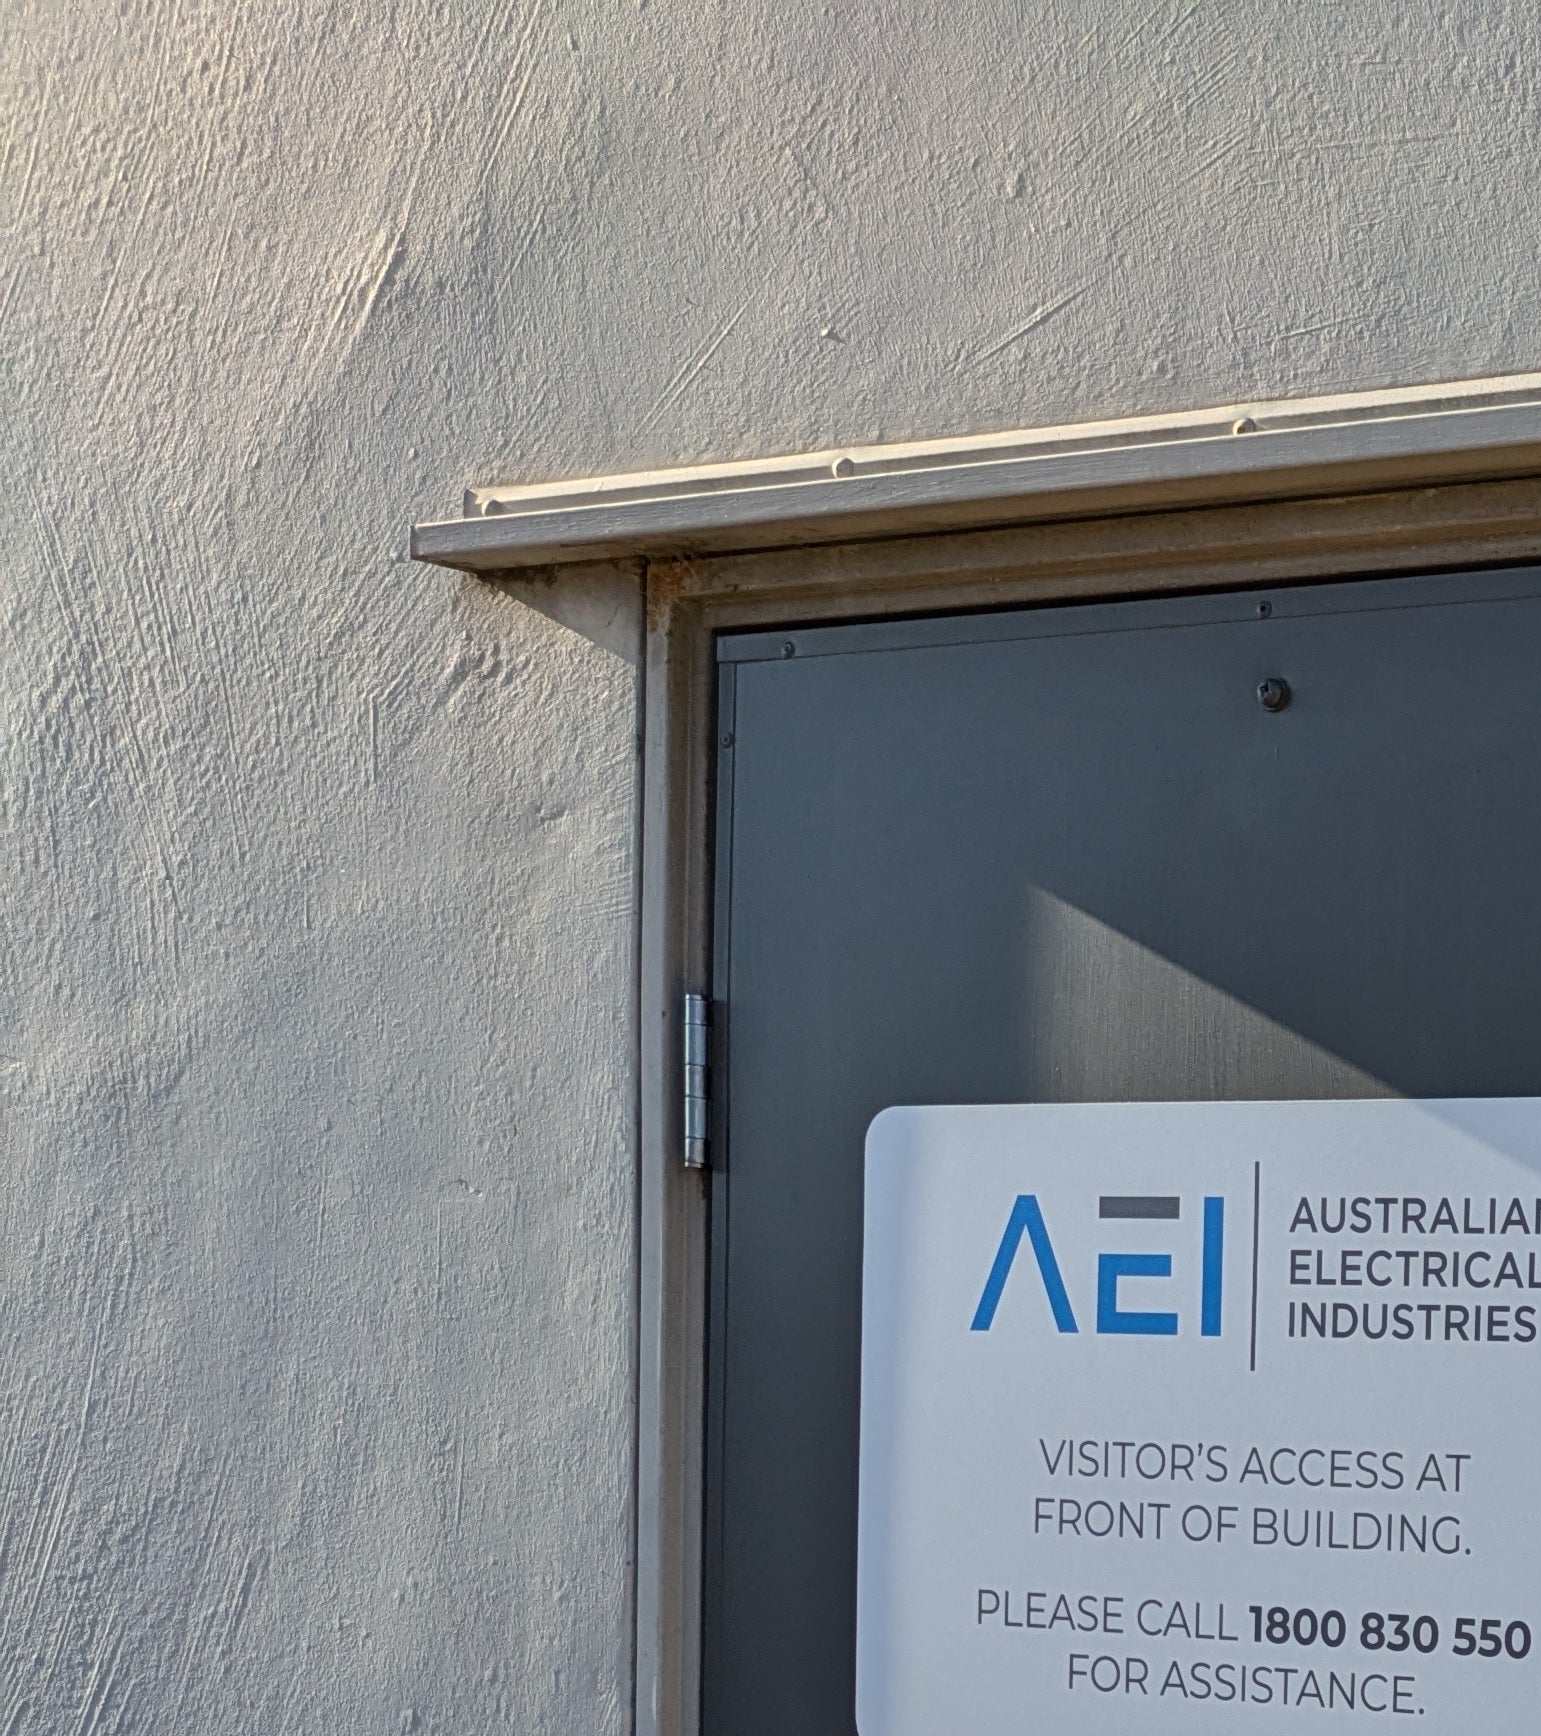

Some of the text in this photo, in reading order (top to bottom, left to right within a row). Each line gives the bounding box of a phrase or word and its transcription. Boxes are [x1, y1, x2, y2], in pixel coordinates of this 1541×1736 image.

[969, 1194, 1225, 1337] AEI
[1288, 1301, 1537, 1343] INDUSTRIES
[1239, 1446, 1404, 1490] ACCESS
[1415, 1453, 1472, 1493] AT
[1034, 1497, 1471, 1556] FRONT OF BUILDING.
[977, 1588, 1532, 1660] PLEASE CALL 1800 830 550
[1068, 1653, 1425, 1715] FOR ASSISTANCE.
